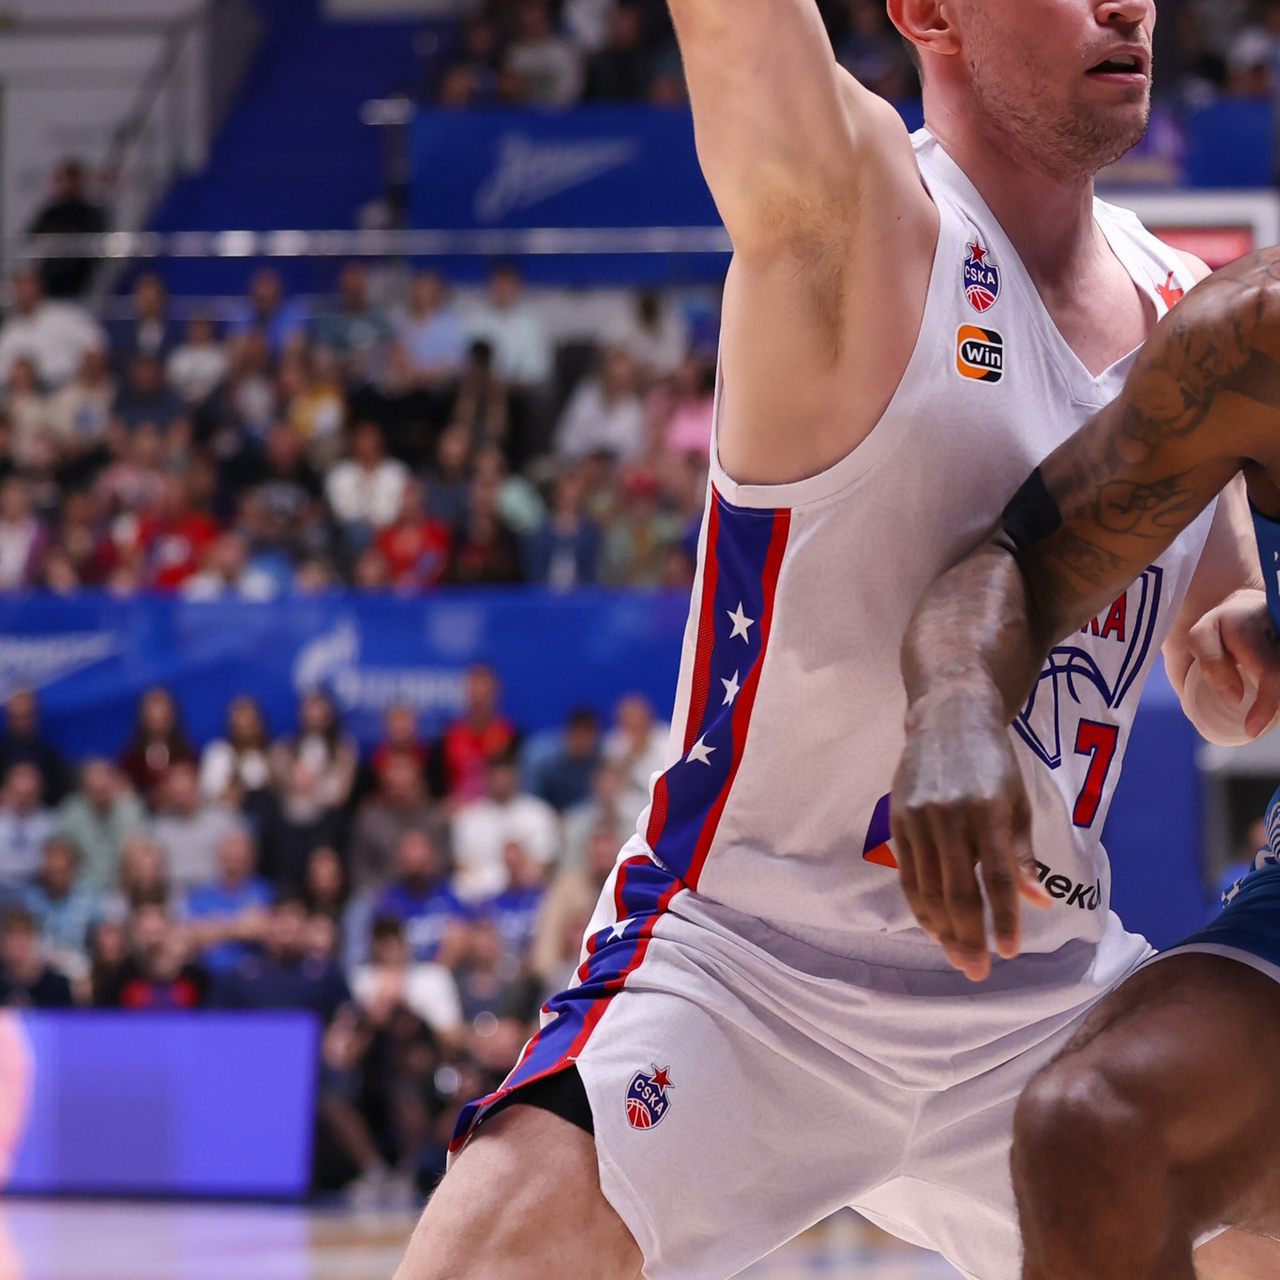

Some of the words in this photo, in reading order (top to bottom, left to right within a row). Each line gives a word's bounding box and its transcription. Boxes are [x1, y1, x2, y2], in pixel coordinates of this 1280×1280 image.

[965, 265, 996, 285] CSKA
[966, 343, 1001, 367] Win
[1072, 718, 1120, 829] 7
[634, 1079, 664, 1116] CSKA
